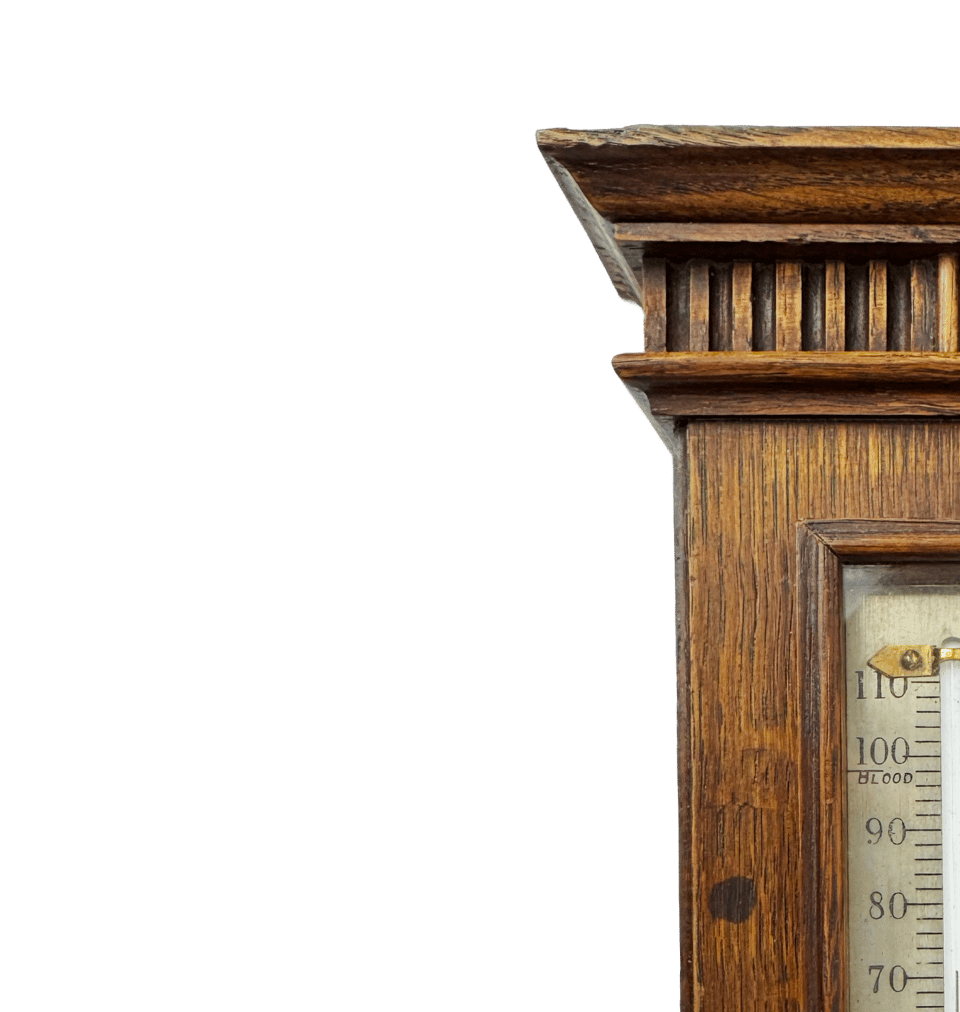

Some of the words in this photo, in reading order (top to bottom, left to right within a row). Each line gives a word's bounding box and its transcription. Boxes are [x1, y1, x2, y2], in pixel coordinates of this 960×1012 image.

[855, 670, 908, 699] 110
[856, 736, 910, 765] 100
[858, 770, 913, 785] BLOOD
[865, 817, 907, 845] 90
[869, 891, 908, 920] 80
[868, 964, 908, 994] 70
